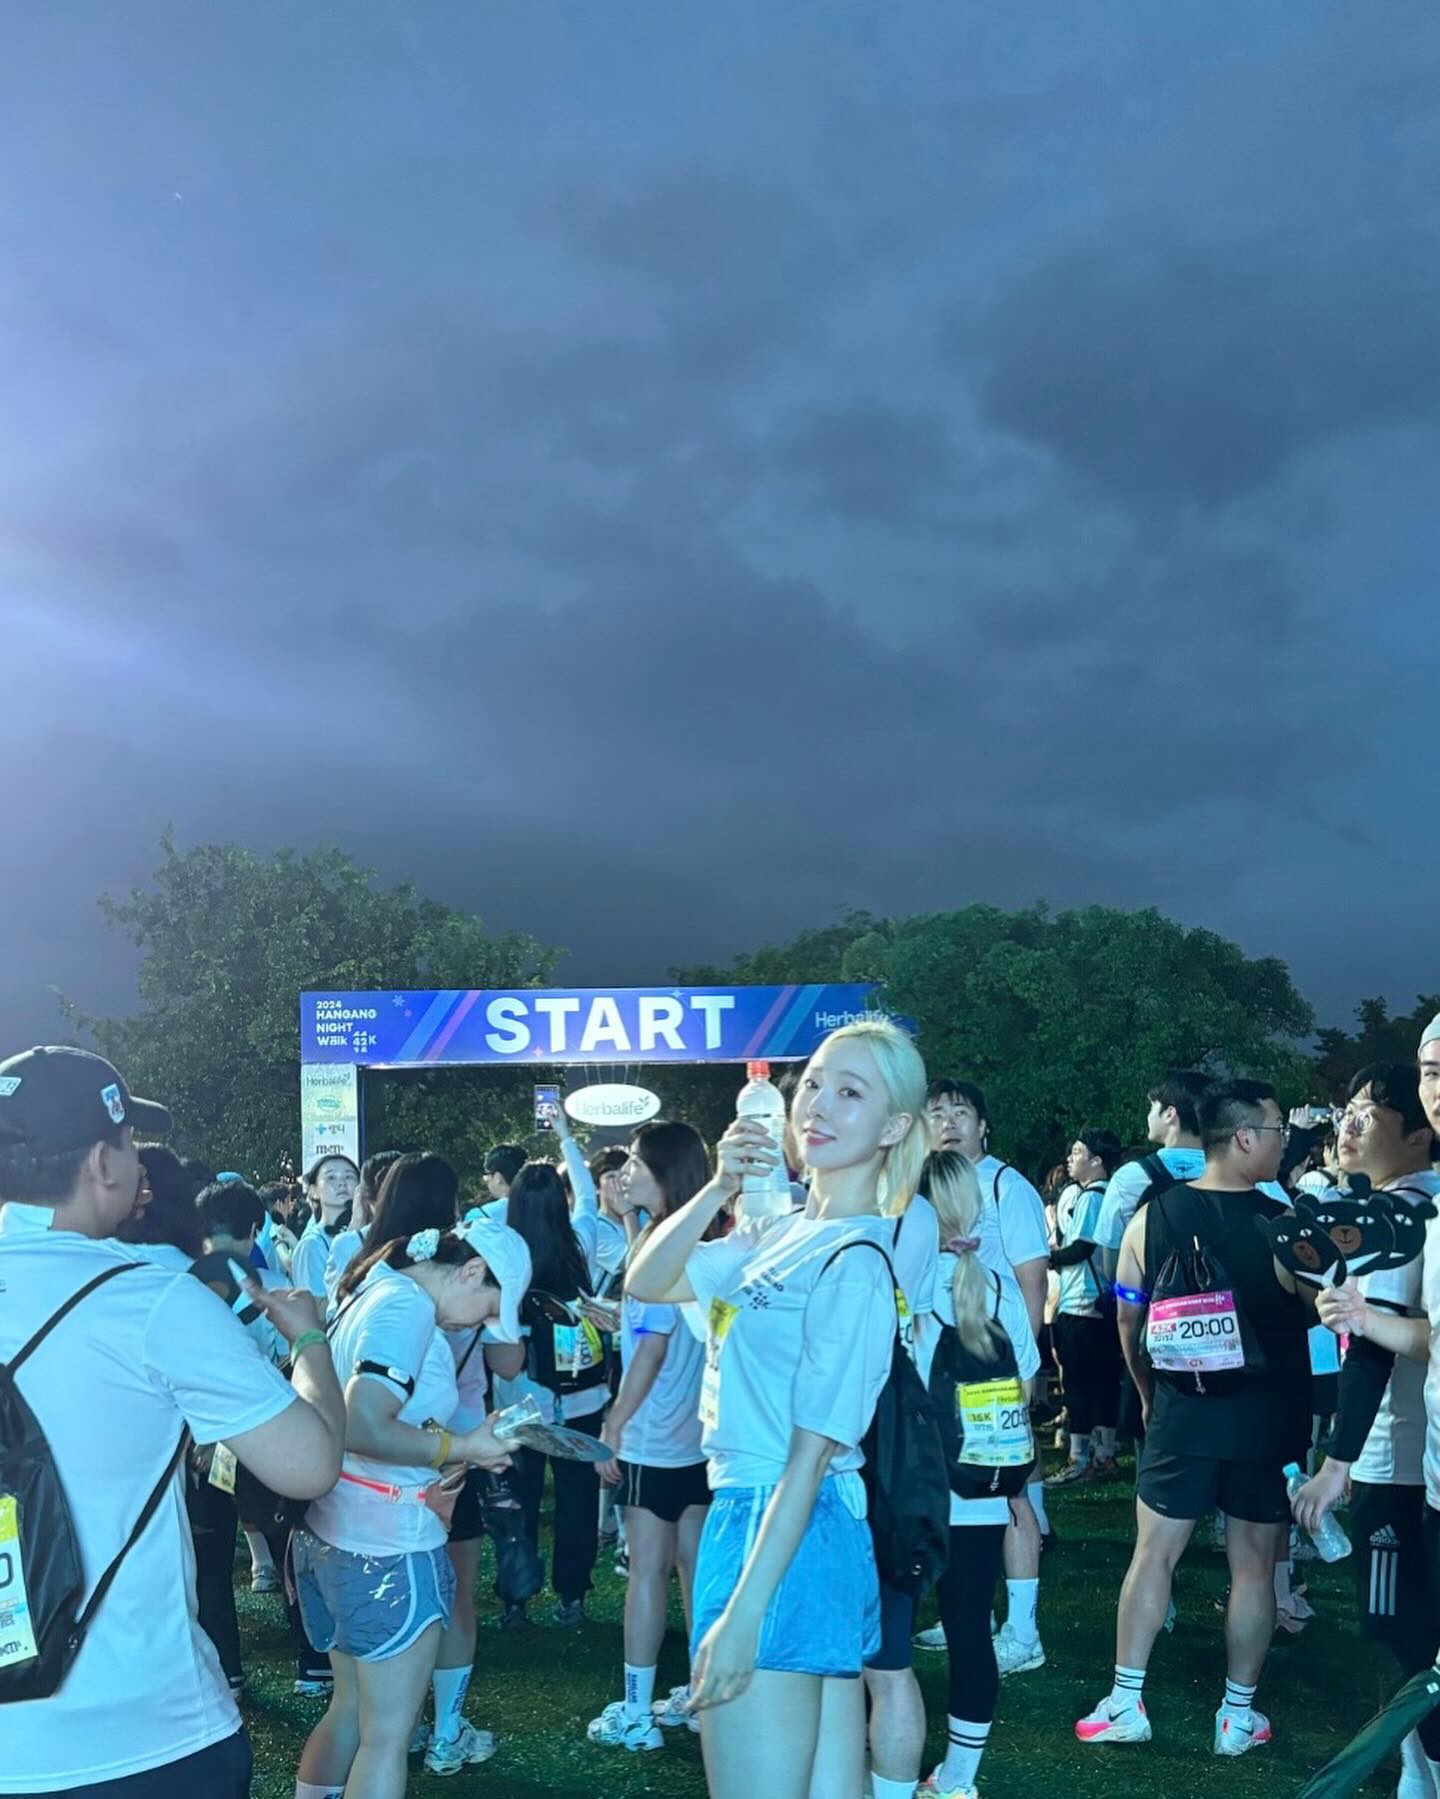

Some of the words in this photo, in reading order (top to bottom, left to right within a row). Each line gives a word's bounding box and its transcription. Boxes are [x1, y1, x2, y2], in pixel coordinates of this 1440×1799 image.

[316, 1000, 342, 1009] 2024
[316, 1009, 377, 1020] HANGANG
[316, 1022, 353, 1033] NIGHT
[485, 995, 735, 1053] START
[575, 1100, 644, 1117] Herbalife
[1179, 1316, 1235, 1339] 20:00
